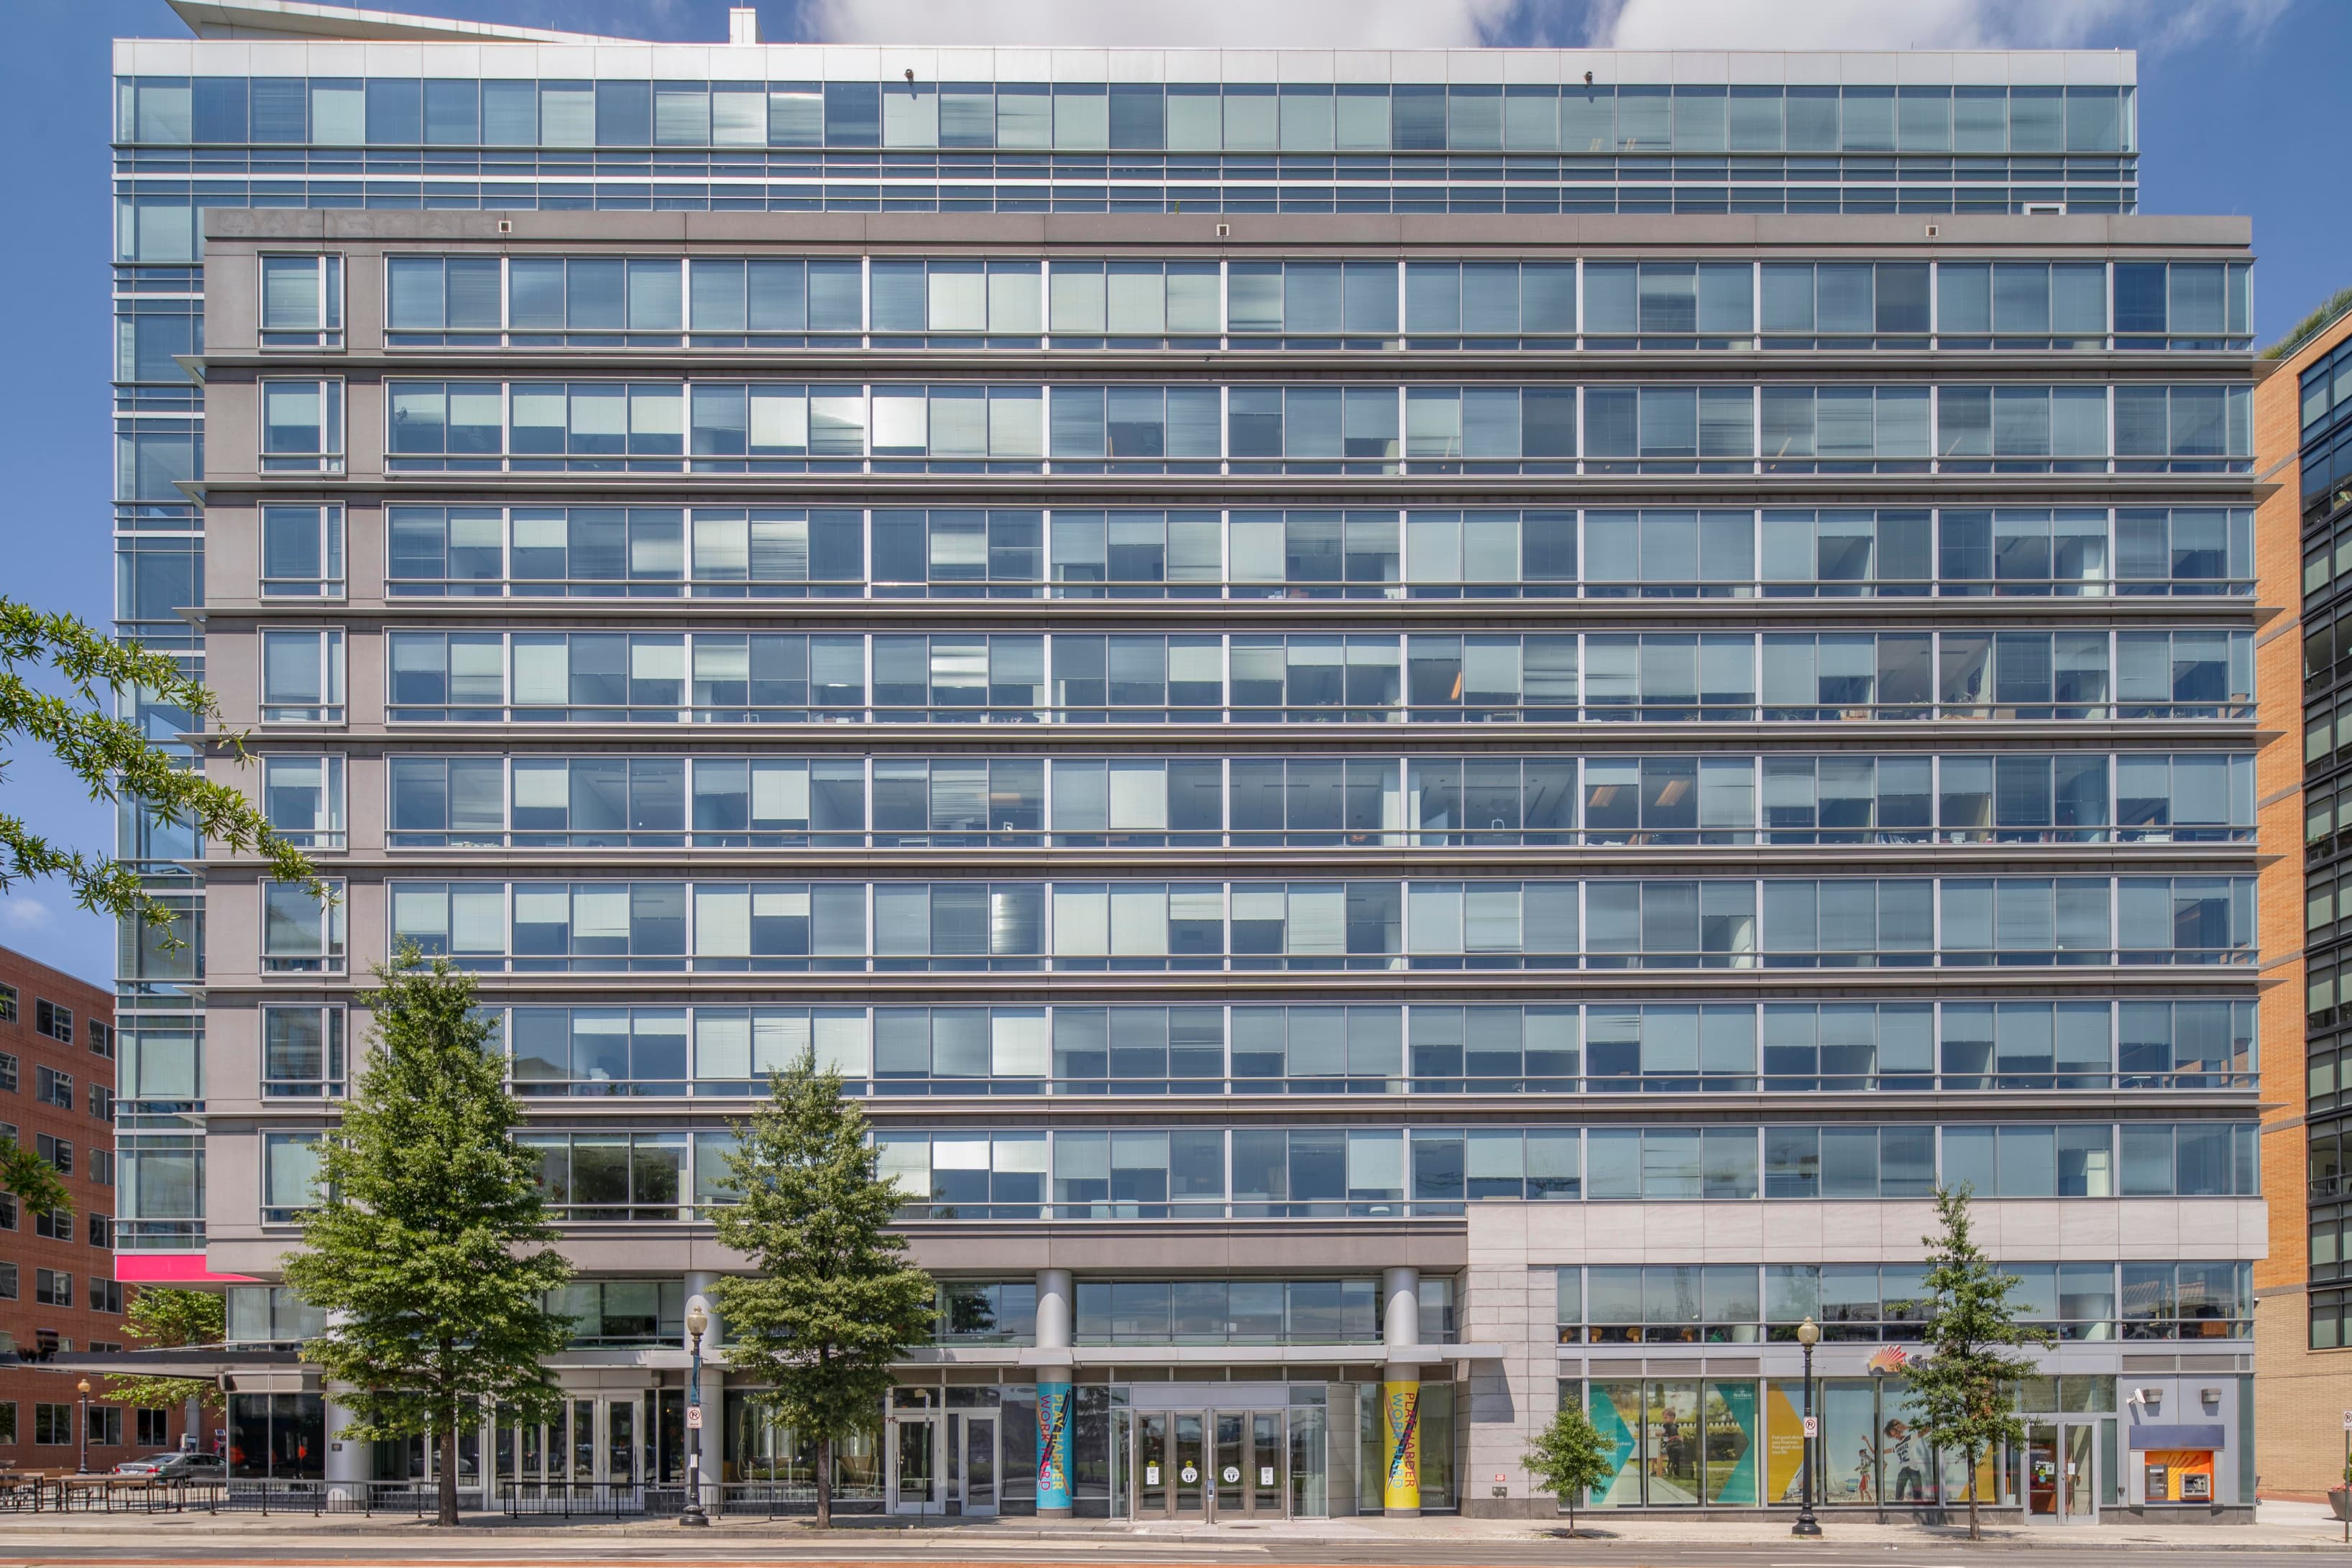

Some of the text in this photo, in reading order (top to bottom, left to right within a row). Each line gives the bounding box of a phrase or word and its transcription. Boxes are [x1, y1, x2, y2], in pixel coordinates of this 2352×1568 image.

[1041, 1395, 1051, 1490] WORK HARD
[1052, 1394, 1064, 1490] PLAY HARDER
[1392, 1393, 1404, 1488] WORK HARD
[1405, 1393, 1415, 1488] PLAY HARDER
